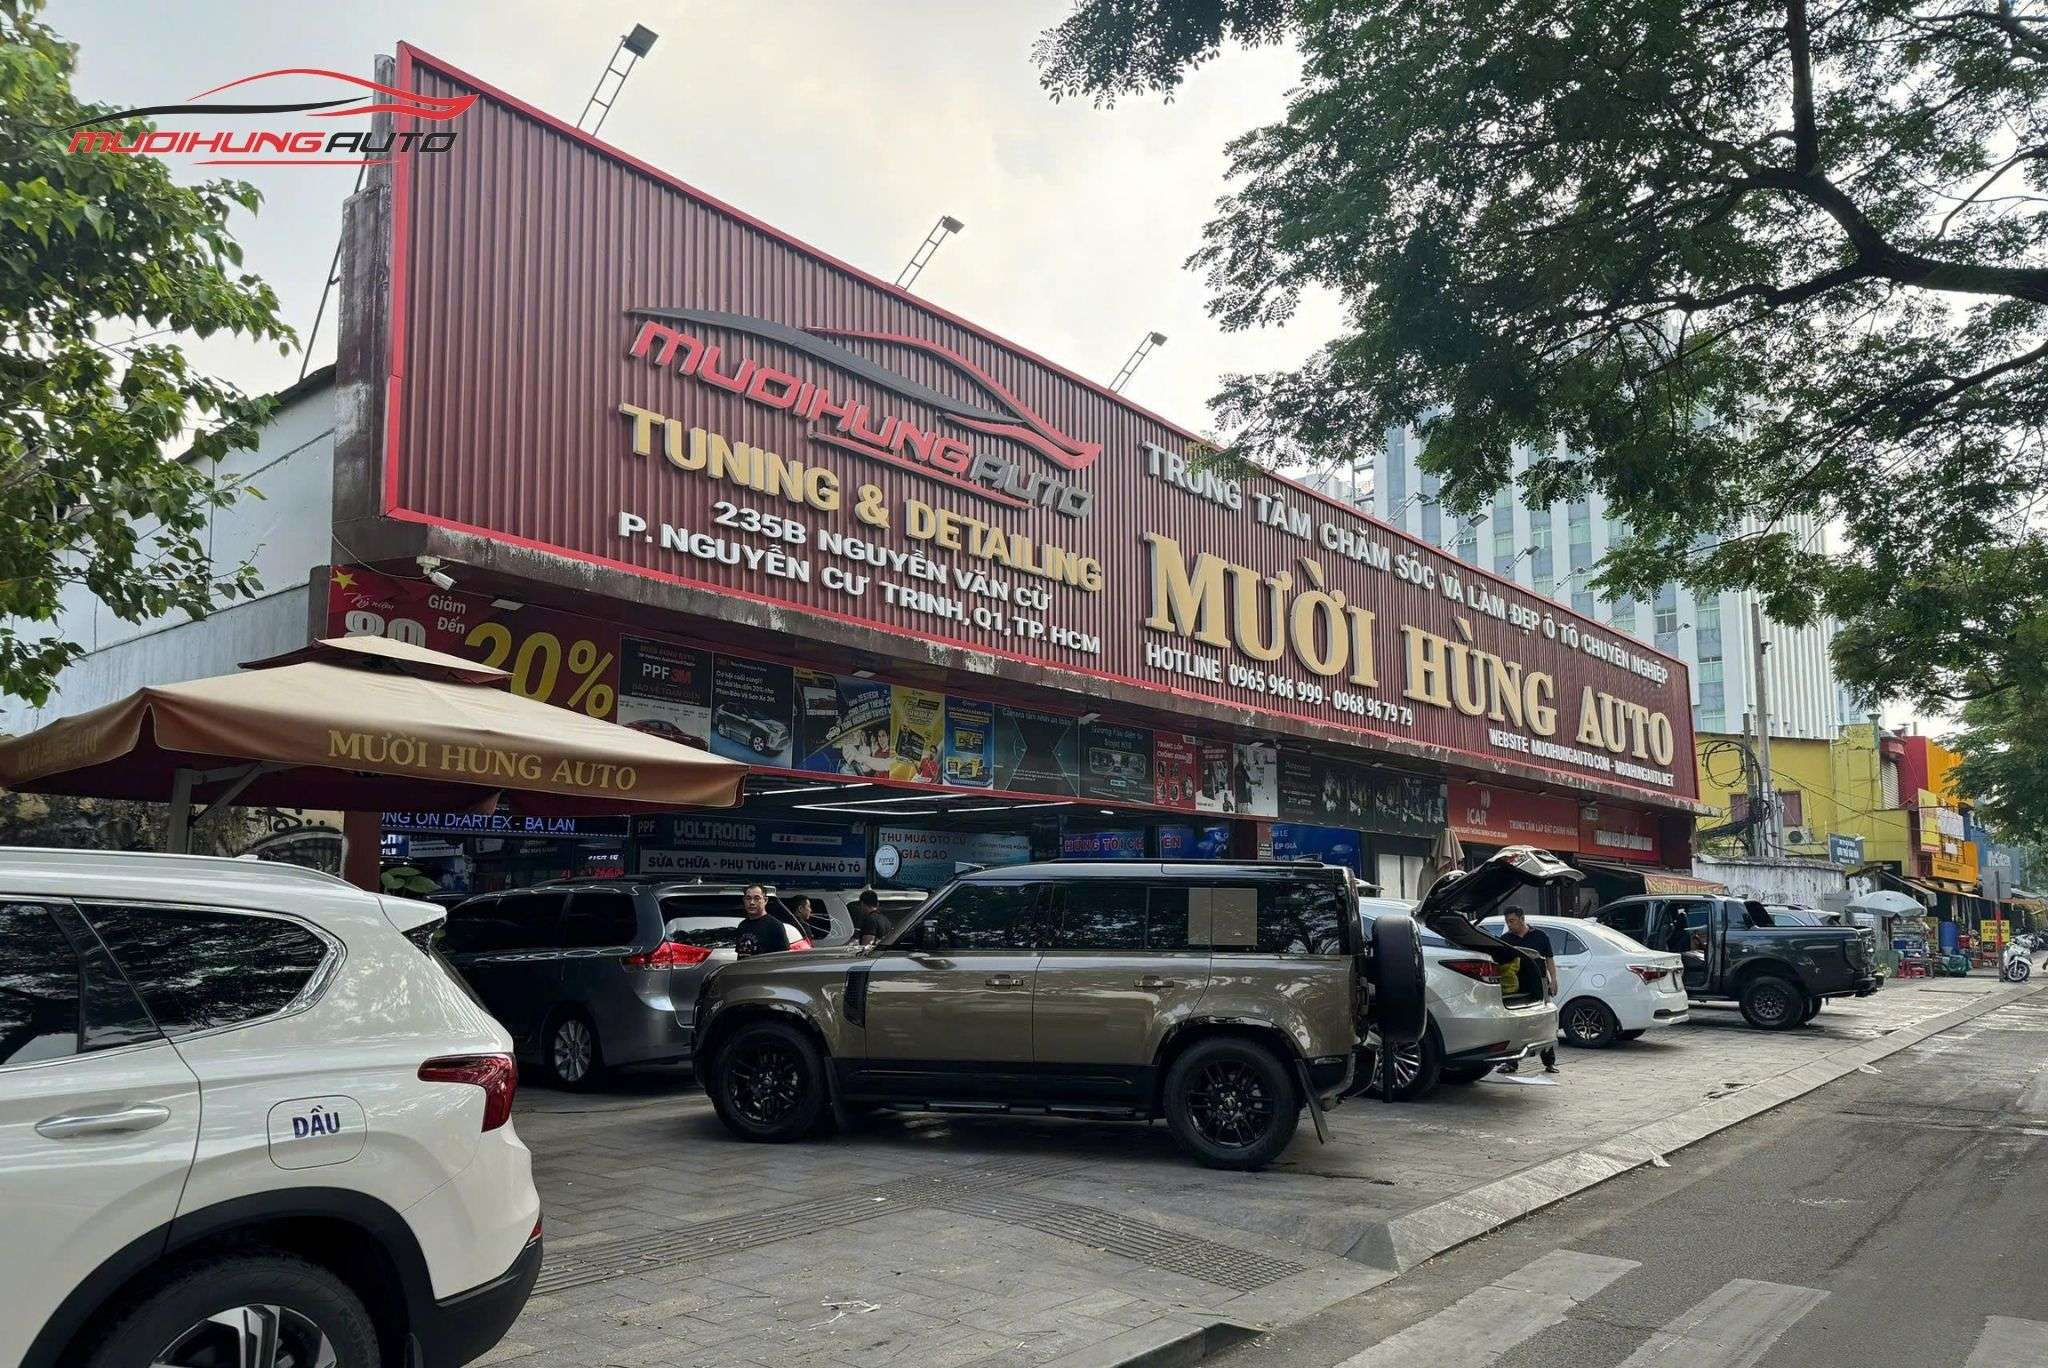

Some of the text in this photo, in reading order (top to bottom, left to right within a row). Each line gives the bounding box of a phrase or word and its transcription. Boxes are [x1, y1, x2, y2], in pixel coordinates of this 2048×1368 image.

[618, 402, 1103, 592] TUNING & DETAILING
[713, 500, 1053, 611] 235B NGUYỄN VĂN CỪ
[1142, 441, 1242, 511] TRUNG
[1254, 492, 1312, 540] TÂM
[1319, 522, 1391, 572] CHĂM
[1439, 568, 1464, 603] VÀ
[1466, 582, 1506, 620] LÀM
[1509, 602, 1540, 636] ĐẸP
[1542, 613, 1555, 639] Ô
[1558, 622, 1579, 649] TÔ
[1581, 632, 1631, 670] CHUYÊN
[1631, 656, 1669, 689] NGHIỆP
[427, 593, 467, 615] Giảm
[618, 512, 653, 543] P.
[660, 525, 811, 583] NGUYỄN
[820, 566, 870, 596] CƯ
[1050, 625, 1101, 655] HCM
[436, 616, 466, 635] Đến
[1143, 530, 1675, 767] MƯỜI HÙNG AUTO
[464, 621, 614, 719] 20%
[642, 663, 671, 680] PPF
[1229, 663, 1265, 693] 0965
[1268, 674, 1295, 700] 966
[1297, 682, 1323, 705] 999
[1333, 690, 1365, 716] 0968
[1367, 698, 1383, 720] 96
[1382, 702, 1399, 723] 79
[1399, 706, 1414, 727] 79
[328, 728, 637, 791] MƯỜI HÙNG AUTO
[445, 813, 513, 830] DrARTEX
[525, 816, 544, 831] BA
[548, 817, 576, 832] LAN
[880, 832, 902, 843] THU
[904, 833, 927, 844] MUA
[648, 851, 674, 869] SỬA
[677, 853, 711, 869] CHỮA
[838, 860, 846, 873] Ô
[848, 861, 861, 874] TÔ
[923, 850, 948, 861] CAO
[291, 1104, 341, 1139] DẦU
